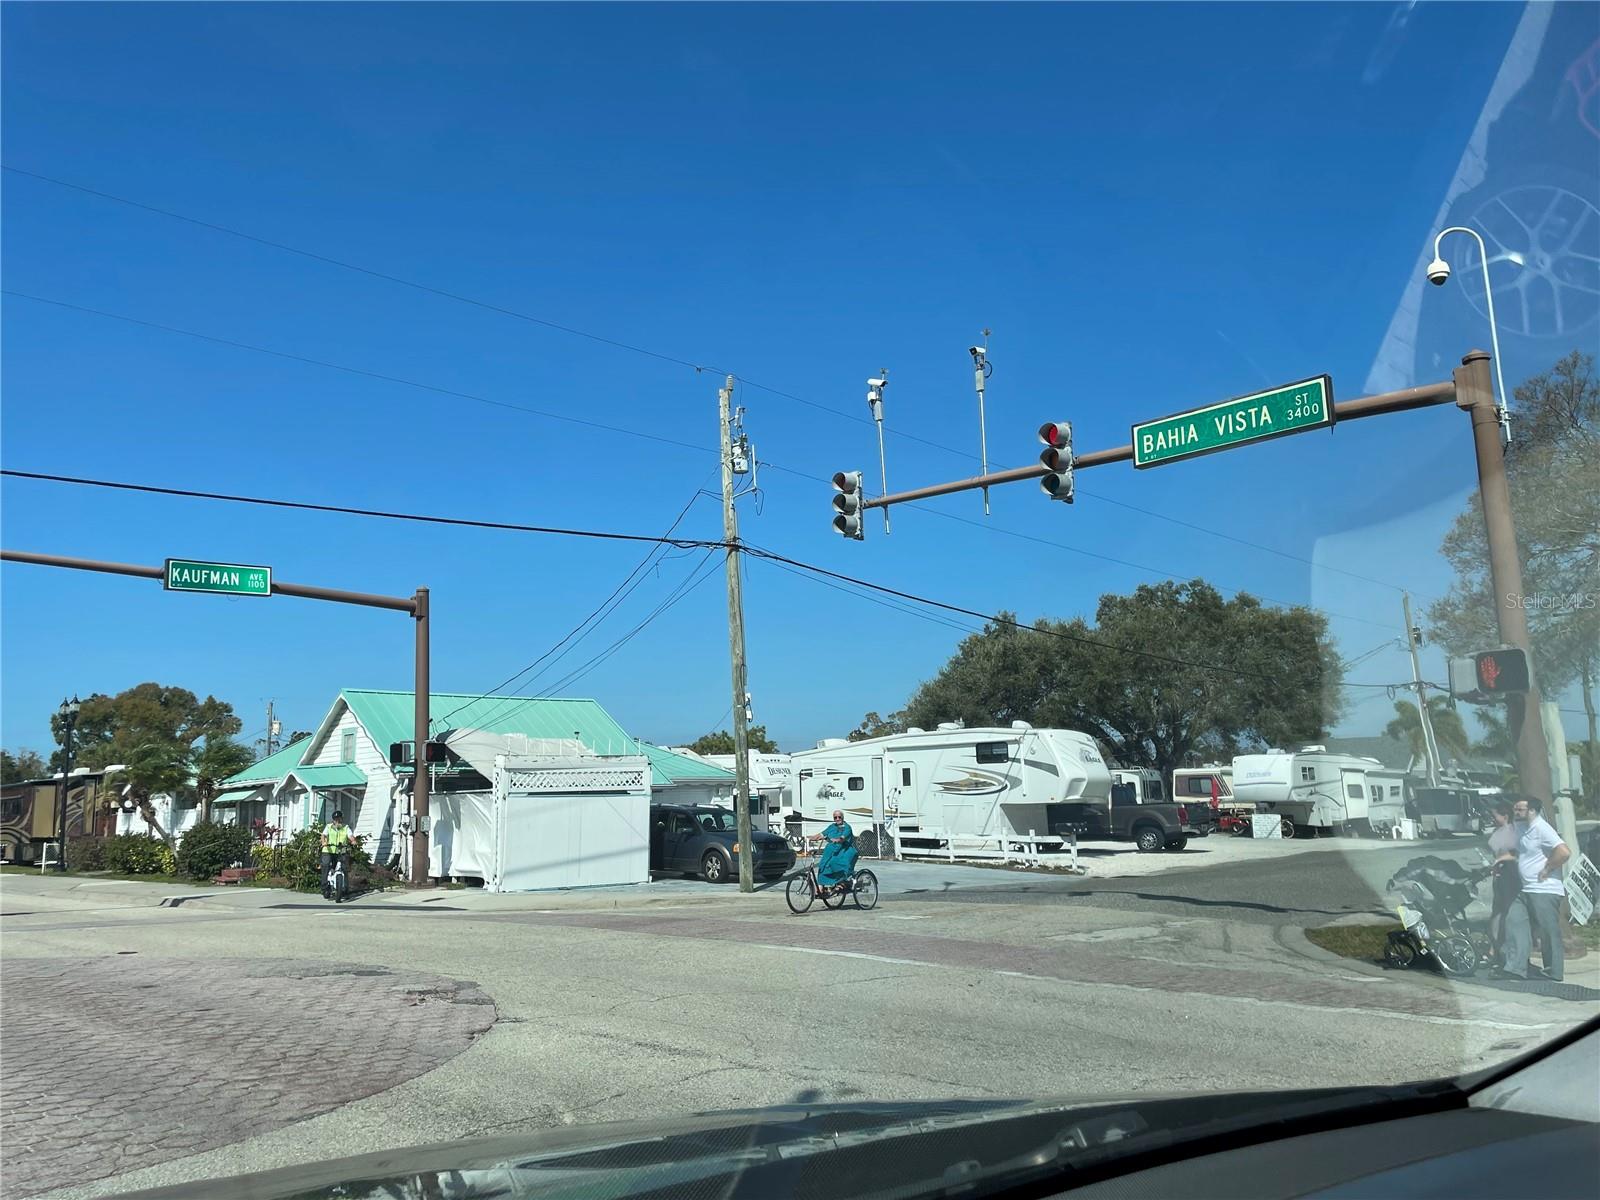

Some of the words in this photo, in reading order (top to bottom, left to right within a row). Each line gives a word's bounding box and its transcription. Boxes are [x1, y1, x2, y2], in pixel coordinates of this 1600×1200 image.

[1295, 393, 1309, 406] ST
[1287, 403, 1320, 421] 3400
[1143, 423, 1199, 454] BAHIA
[1214, 405, 1272, 436] VISTA
[172, 567, 239, 586] KAUFMAN
[248, 580, 265, 588] 1100
[249, 573, 263, 581] AVE
